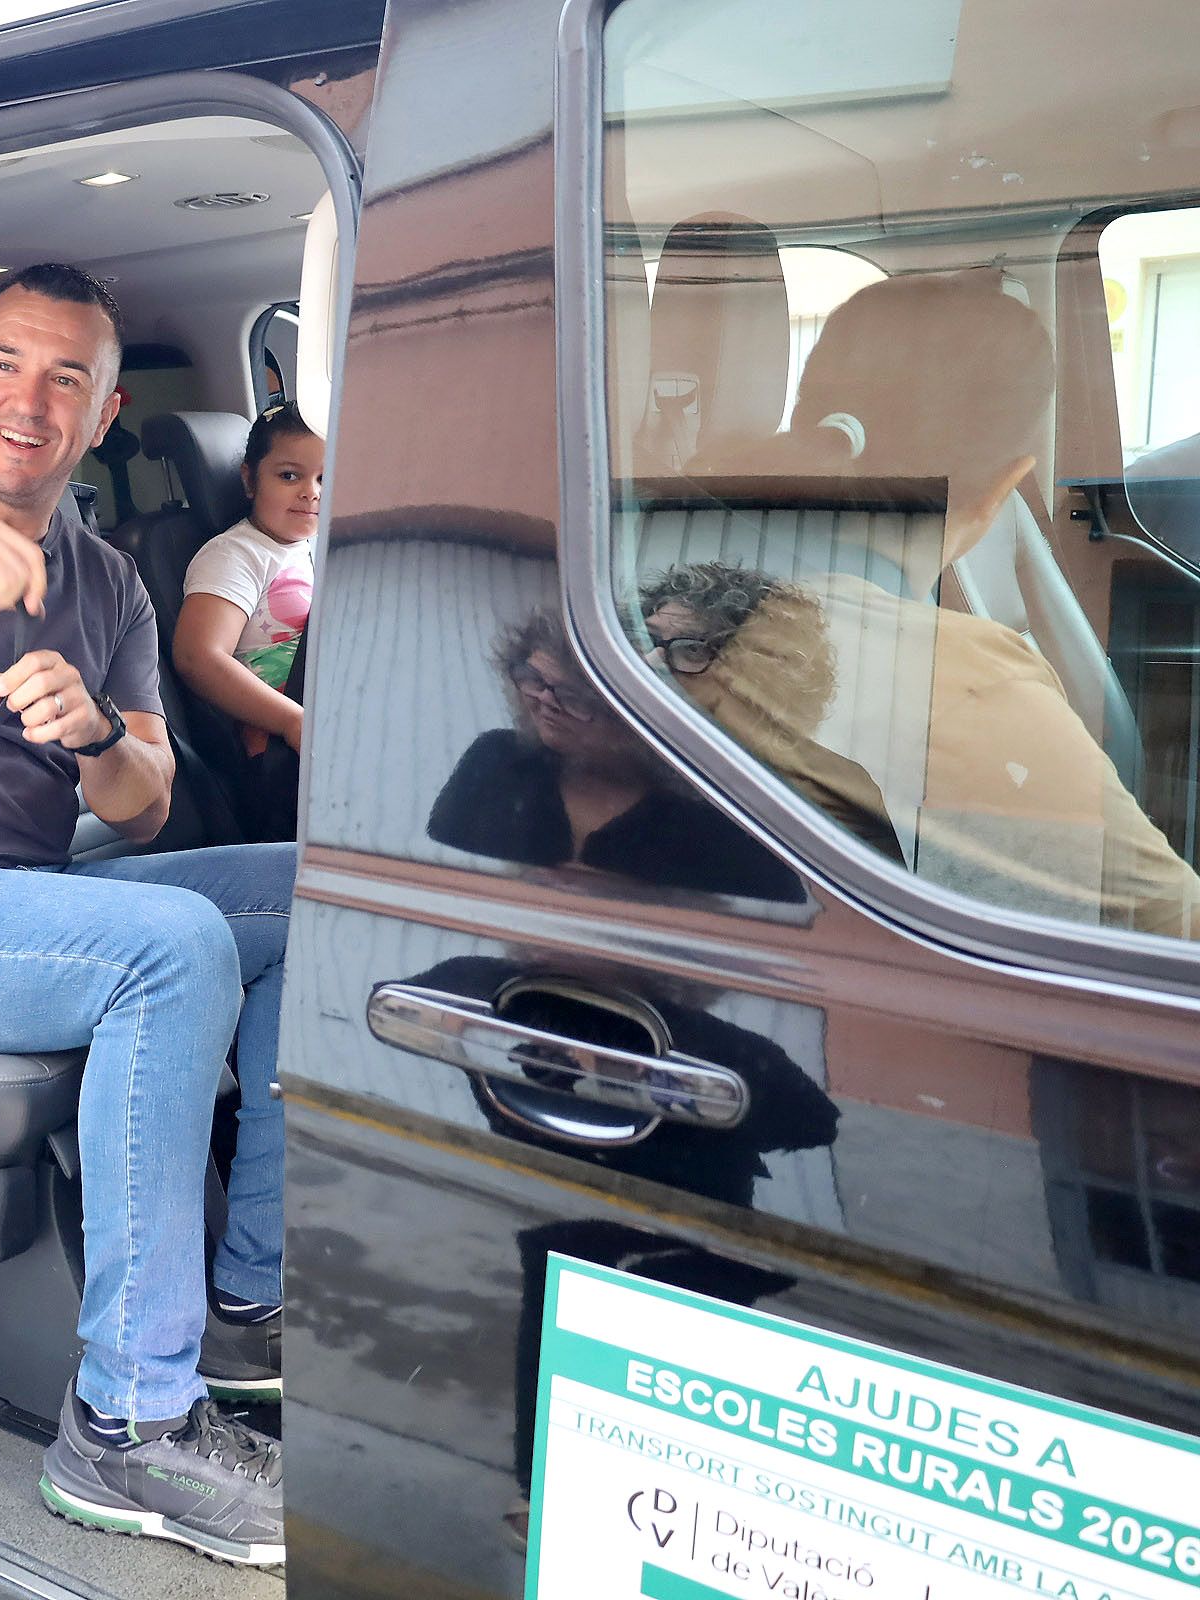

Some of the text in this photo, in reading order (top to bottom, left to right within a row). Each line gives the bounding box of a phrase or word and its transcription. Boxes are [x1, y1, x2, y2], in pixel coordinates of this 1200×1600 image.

[626, 1358, 1200, 1577] ESCOLES RURALS 2026
[796, 1364, 1077, 1479] AJUDES A
[173, 1471, 218, 1496] LACOSTE
[574, 1410, 1080, 1600] TRANSPORT SOSTINGUT AMB LA
[711, 1551, 843, 1600] de Valè
[714, 1509, 875, 1588] Diputació
